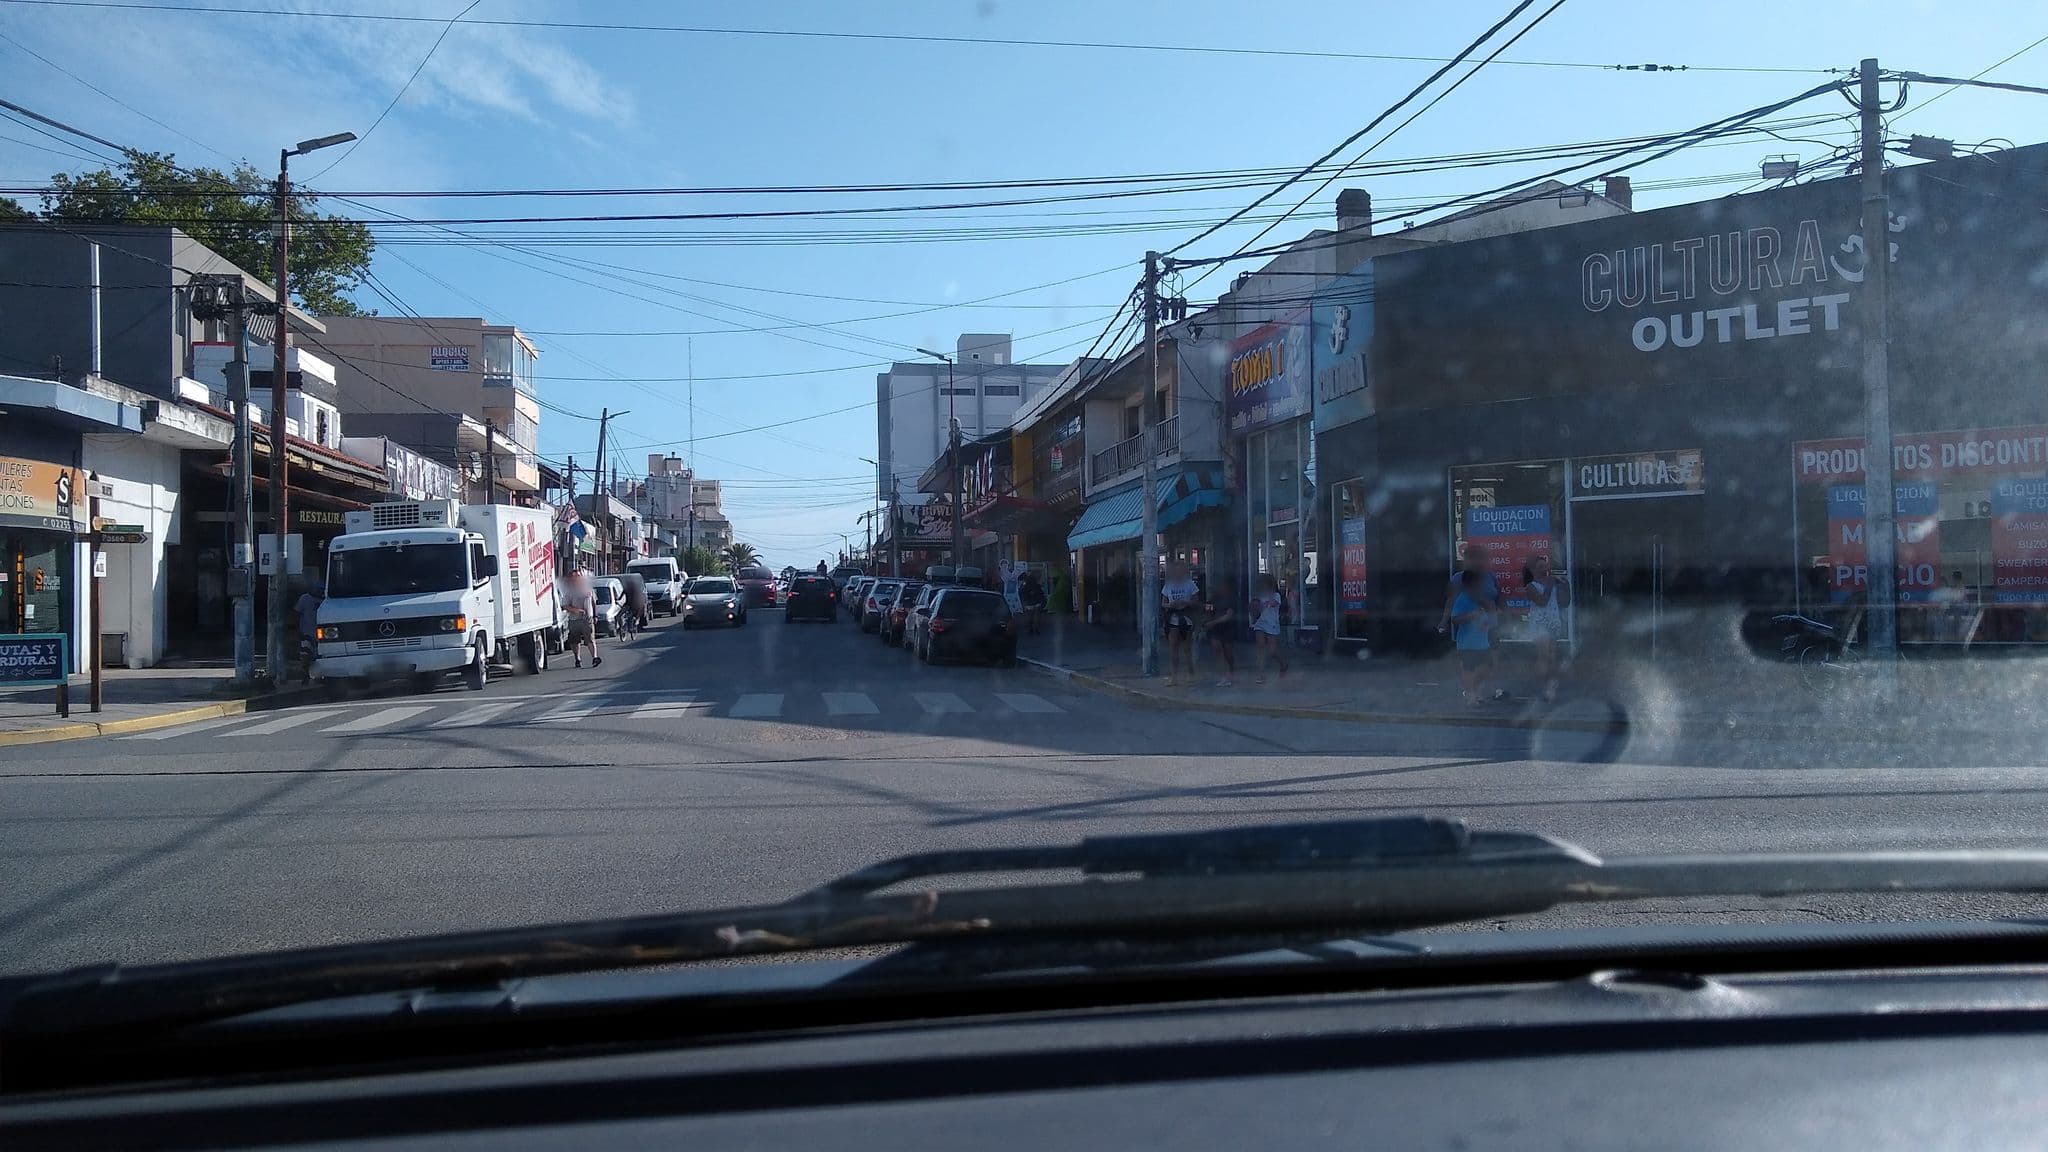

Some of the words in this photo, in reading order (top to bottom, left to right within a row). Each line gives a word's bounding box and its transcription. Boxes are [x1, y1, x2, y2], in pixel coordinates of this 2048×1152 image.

[1582, 219, 1827, 312] CULTURA
[1632, 293, 1849, 352] OUTLET
[1231, 342, 1274, 398] TOMA
[1803, 444, 1932, 474] PRODTOS
[1581, 459, 1669, 489] CULTURA
[1836, 486, 1930, 502] LIQUCION
[2025, 496, 2048, 509] TO
[1472, 509, 1544, 522] LIQUIDACION
[102, 532, 125, 541] Paseo
[1490, 521, 1526, 533] TOTAL
[1836, 564, 1935, 586] PRIO
[46, 644, 56, 655] Y
